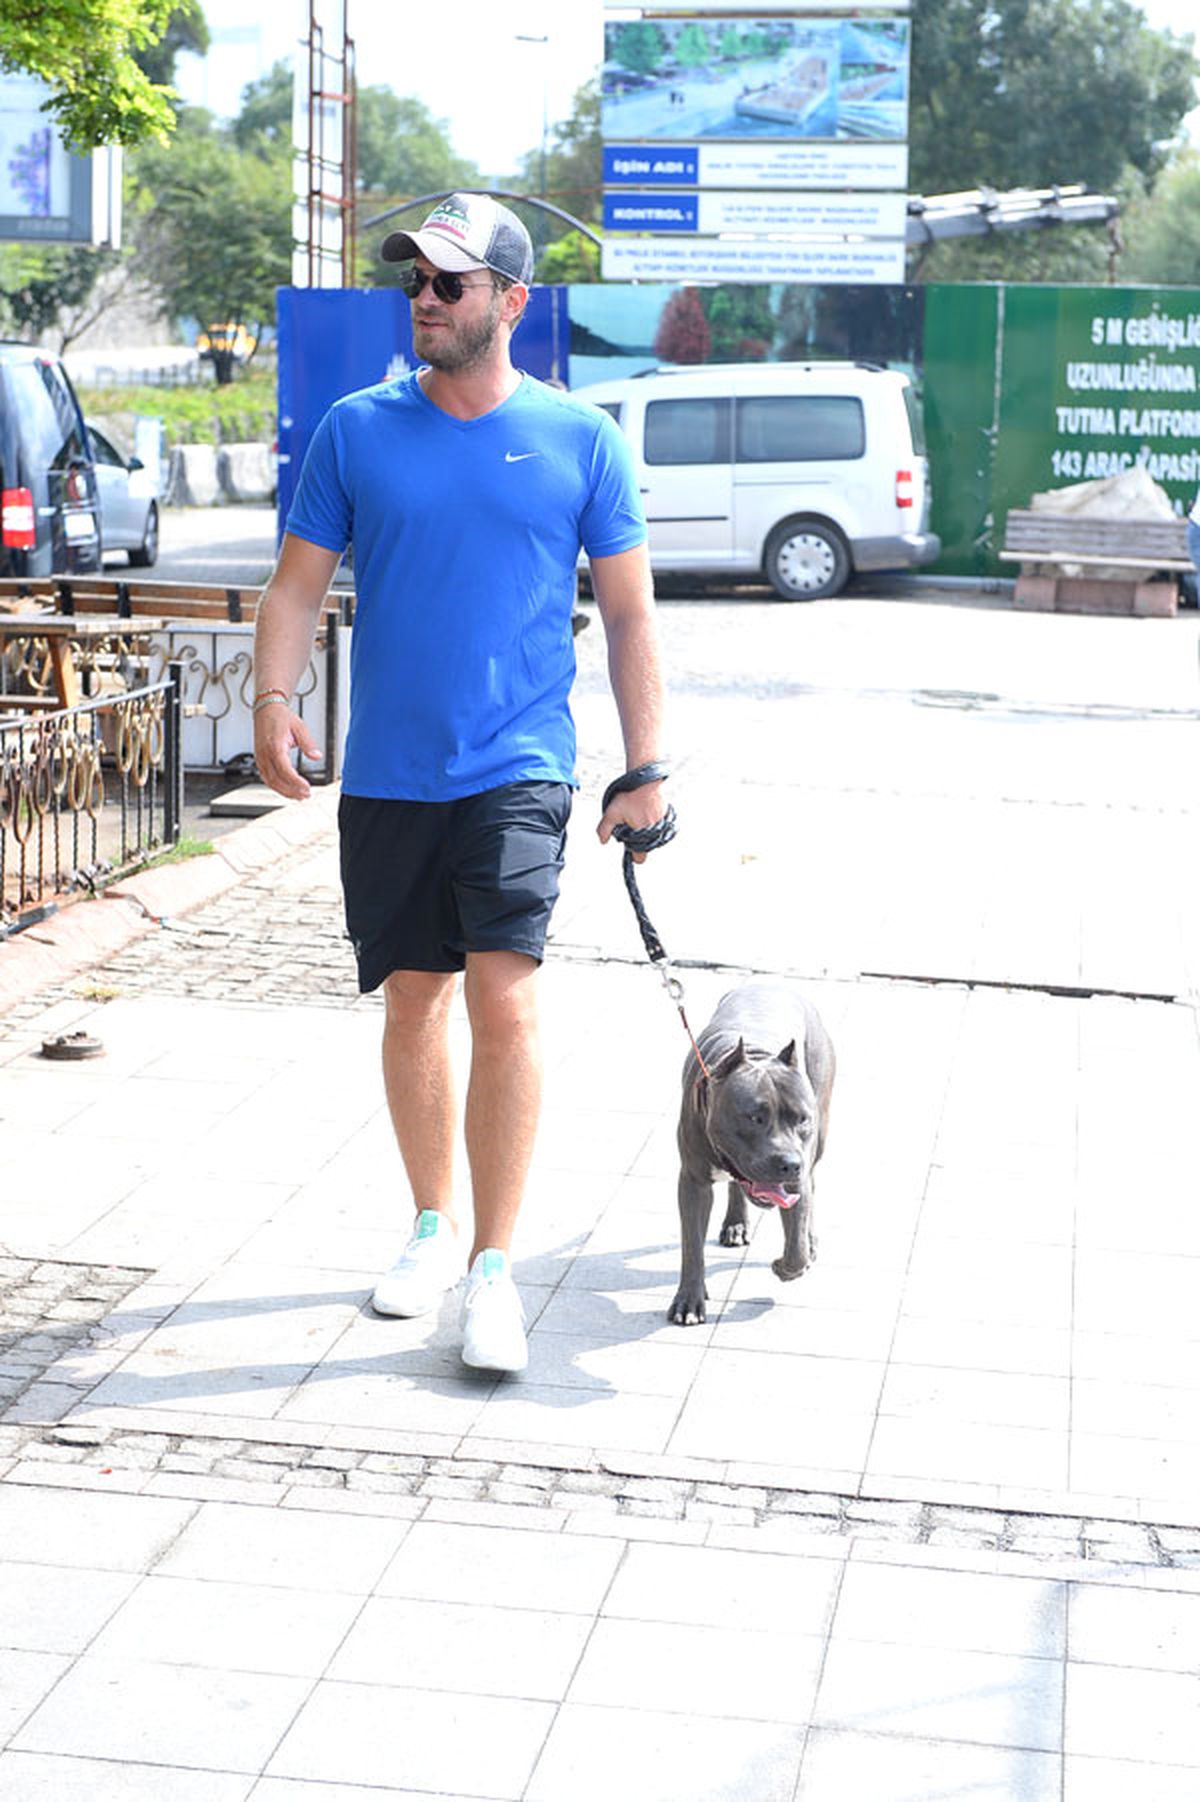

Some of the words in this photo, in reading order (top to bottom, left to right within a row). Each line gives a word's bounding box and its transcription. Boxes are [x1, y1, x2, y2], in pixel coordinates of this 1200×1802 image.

[653, 161, 684, 173] ADI
[613, 208, 684, 221] KONTROL
[1106, 317, 1122, 345] M
[1056, 407, 1116, 434] TUTMA
[1052, 450, 1082, 477] 143
